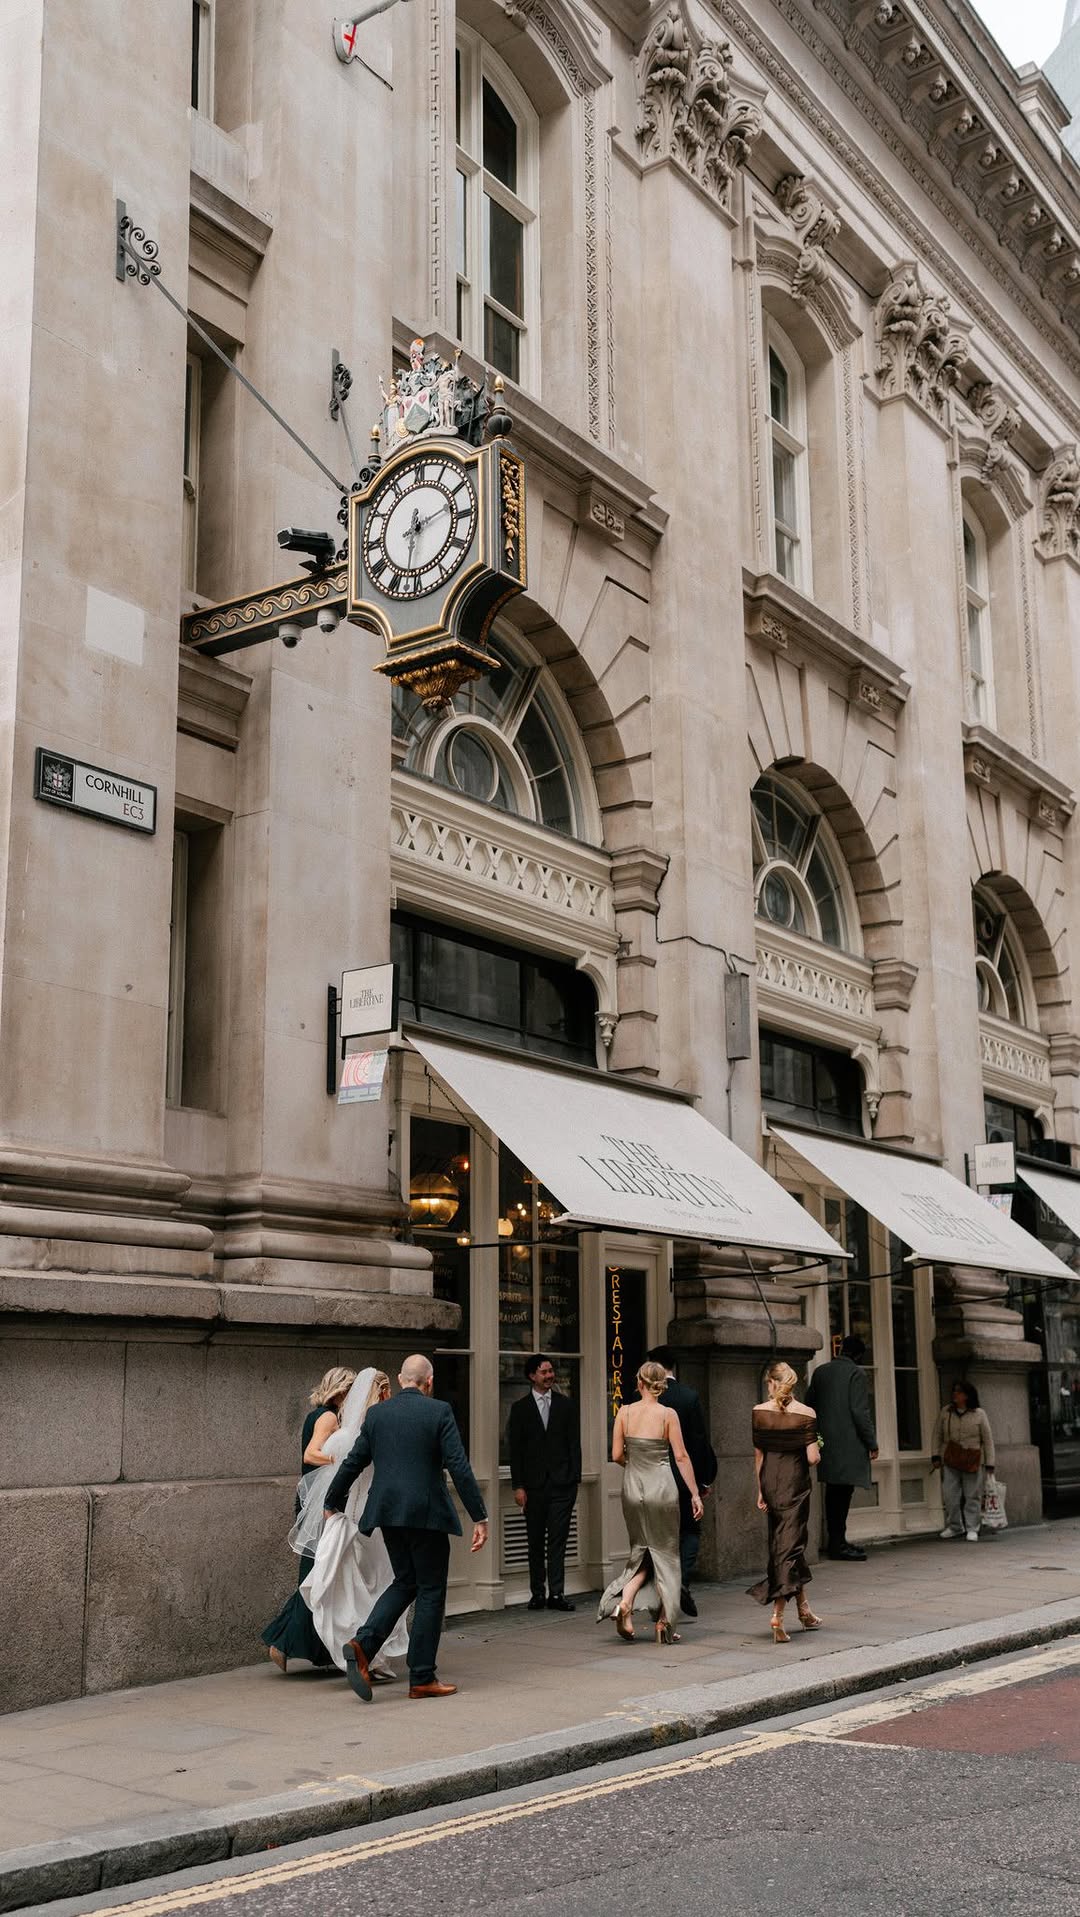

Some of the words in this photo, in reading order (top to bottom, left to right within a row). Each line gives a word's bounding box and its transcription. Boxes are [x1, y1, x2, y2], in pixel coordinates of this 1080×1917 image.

[57, 791, 71, 799] LONDON
[85, 774, 144, 805] CORNHILL
[123, 803, 144, 820] EC3
[349, 993, 384, 1009] LIBERTINE
[361, 988, 374, 999] THE
[600, 1134, 673, 1171] THE
[578, 1155, 752, 1215] LIBERTINE
[499, 1311, 528, 1324] RAUGHT
[611, 1274, 624, 1418] RESTAURAN
